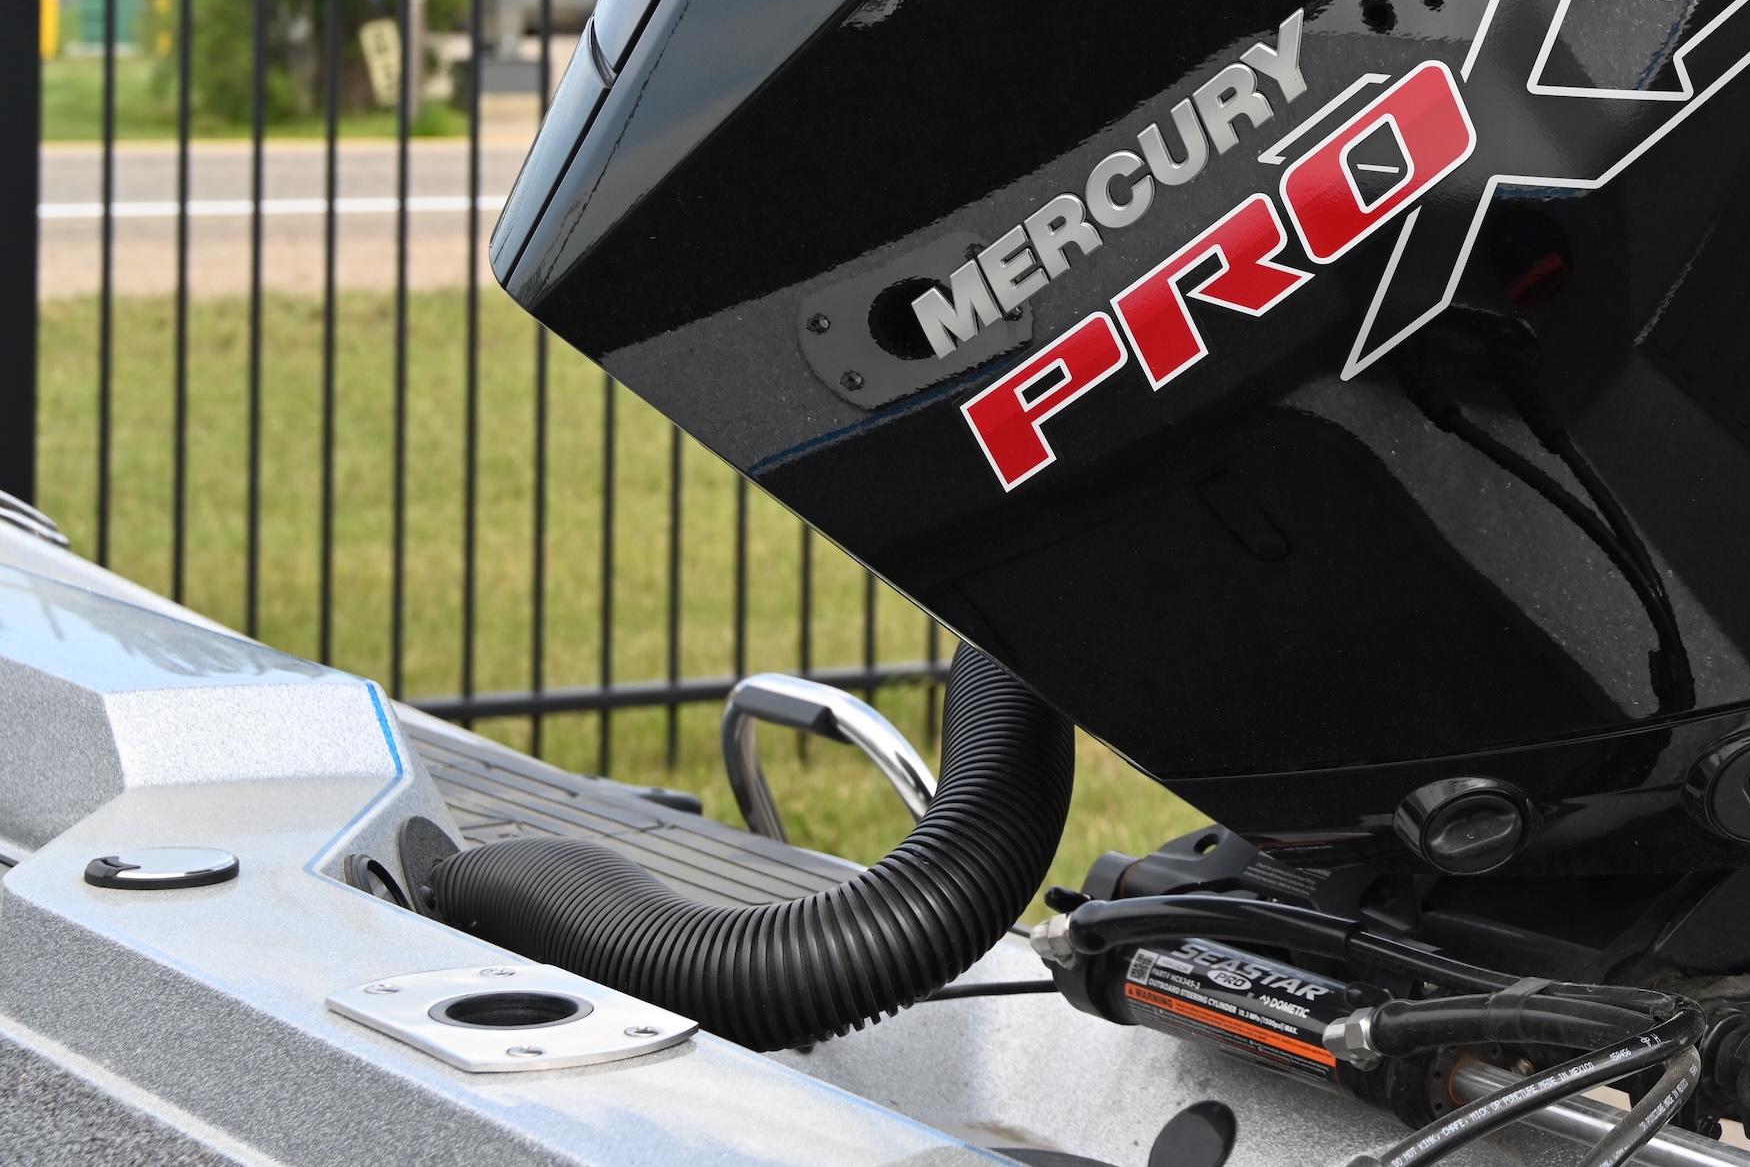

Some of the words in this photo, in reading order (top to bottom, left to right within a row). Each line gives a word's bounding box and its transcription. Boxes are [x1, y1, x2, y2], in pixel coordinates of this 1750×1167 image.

[909, 7, 1306, 360] MERCURY
[960, 59, 1477, 492] PRO
[1171, 944, 1330, 1001] SEASTAR
[1214, 972, 1247, 987] PRO
[1135, 987, 1174, 1009] WARNING
[1148, 978, 1180, 995] OUTBOARD
[1180, 988, 1209, 1004] STEERING
[1208, 998, 1238, 1014] CYLINDER
[1269, 997, 1311, 1018] DOMETIC
[1391, 1157, 1403, 1167] DO
[1403, 1146, 1417, 1161] NOT
[1469, 1105, 1490, 1121] NICK
[1490, 1100, 1502, 1111] OR
[1502, 1084, 1538, 1106] PUNCTURE
[1537, 1076, 1558, 1090] MADE
[1558, 1071, 1569, 1082] IN
[1568, 1061, 1595, 1078] MEXICO
